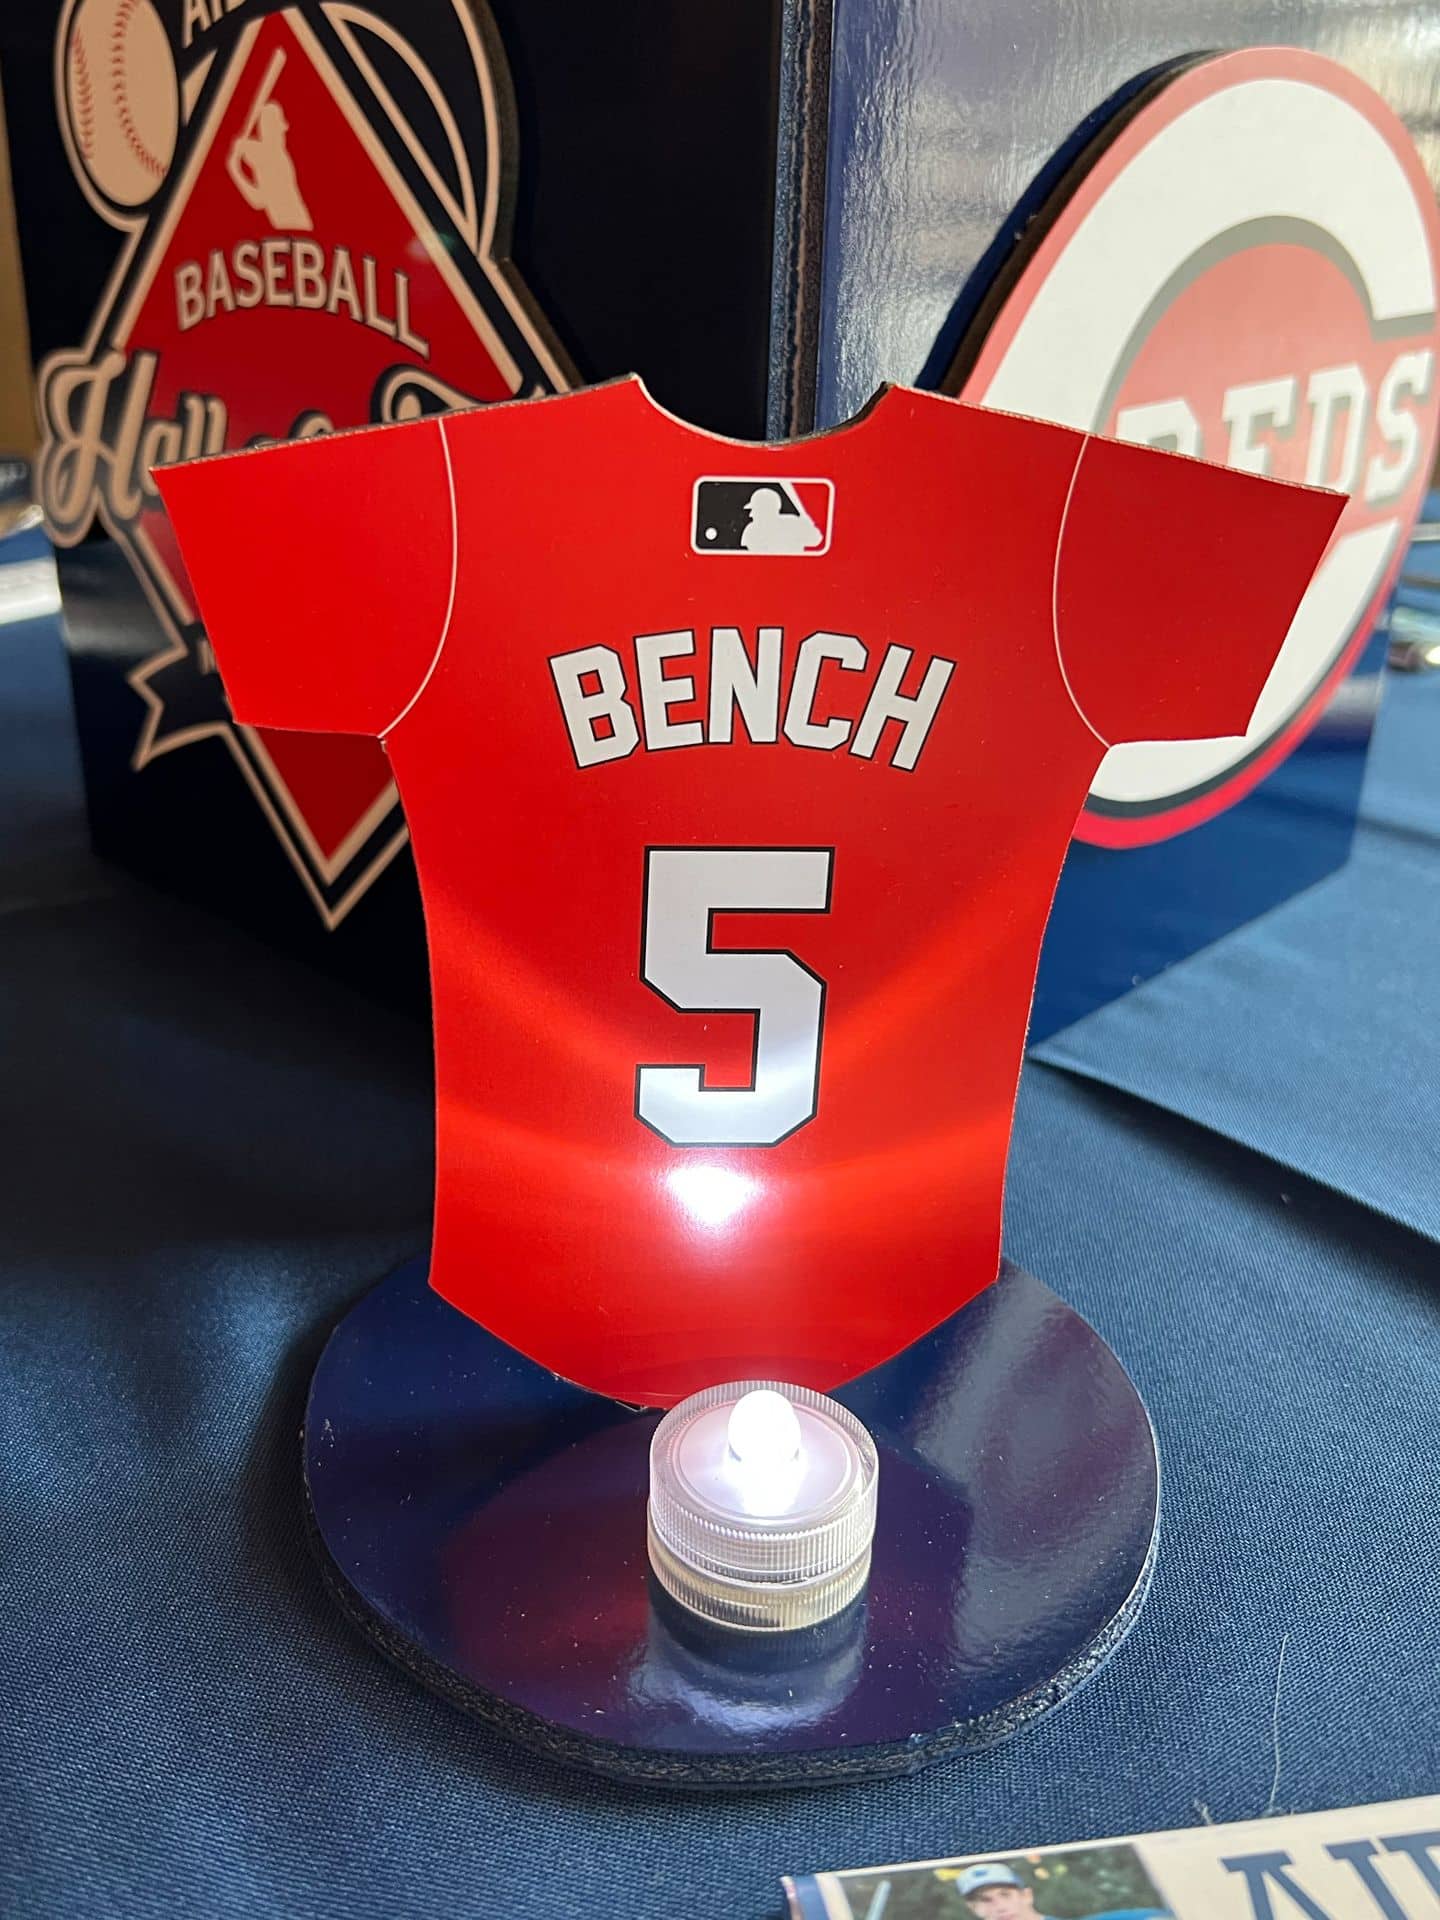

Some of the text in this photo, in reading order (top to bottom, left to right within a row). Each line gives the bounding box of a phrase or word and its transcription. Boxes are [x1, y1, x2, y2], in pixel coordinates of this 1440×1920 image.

[174, 238, 430, 358] BASEBALL
[548, 627, 956, 772] BENCH
[634, 846, 835, 1147] 5
